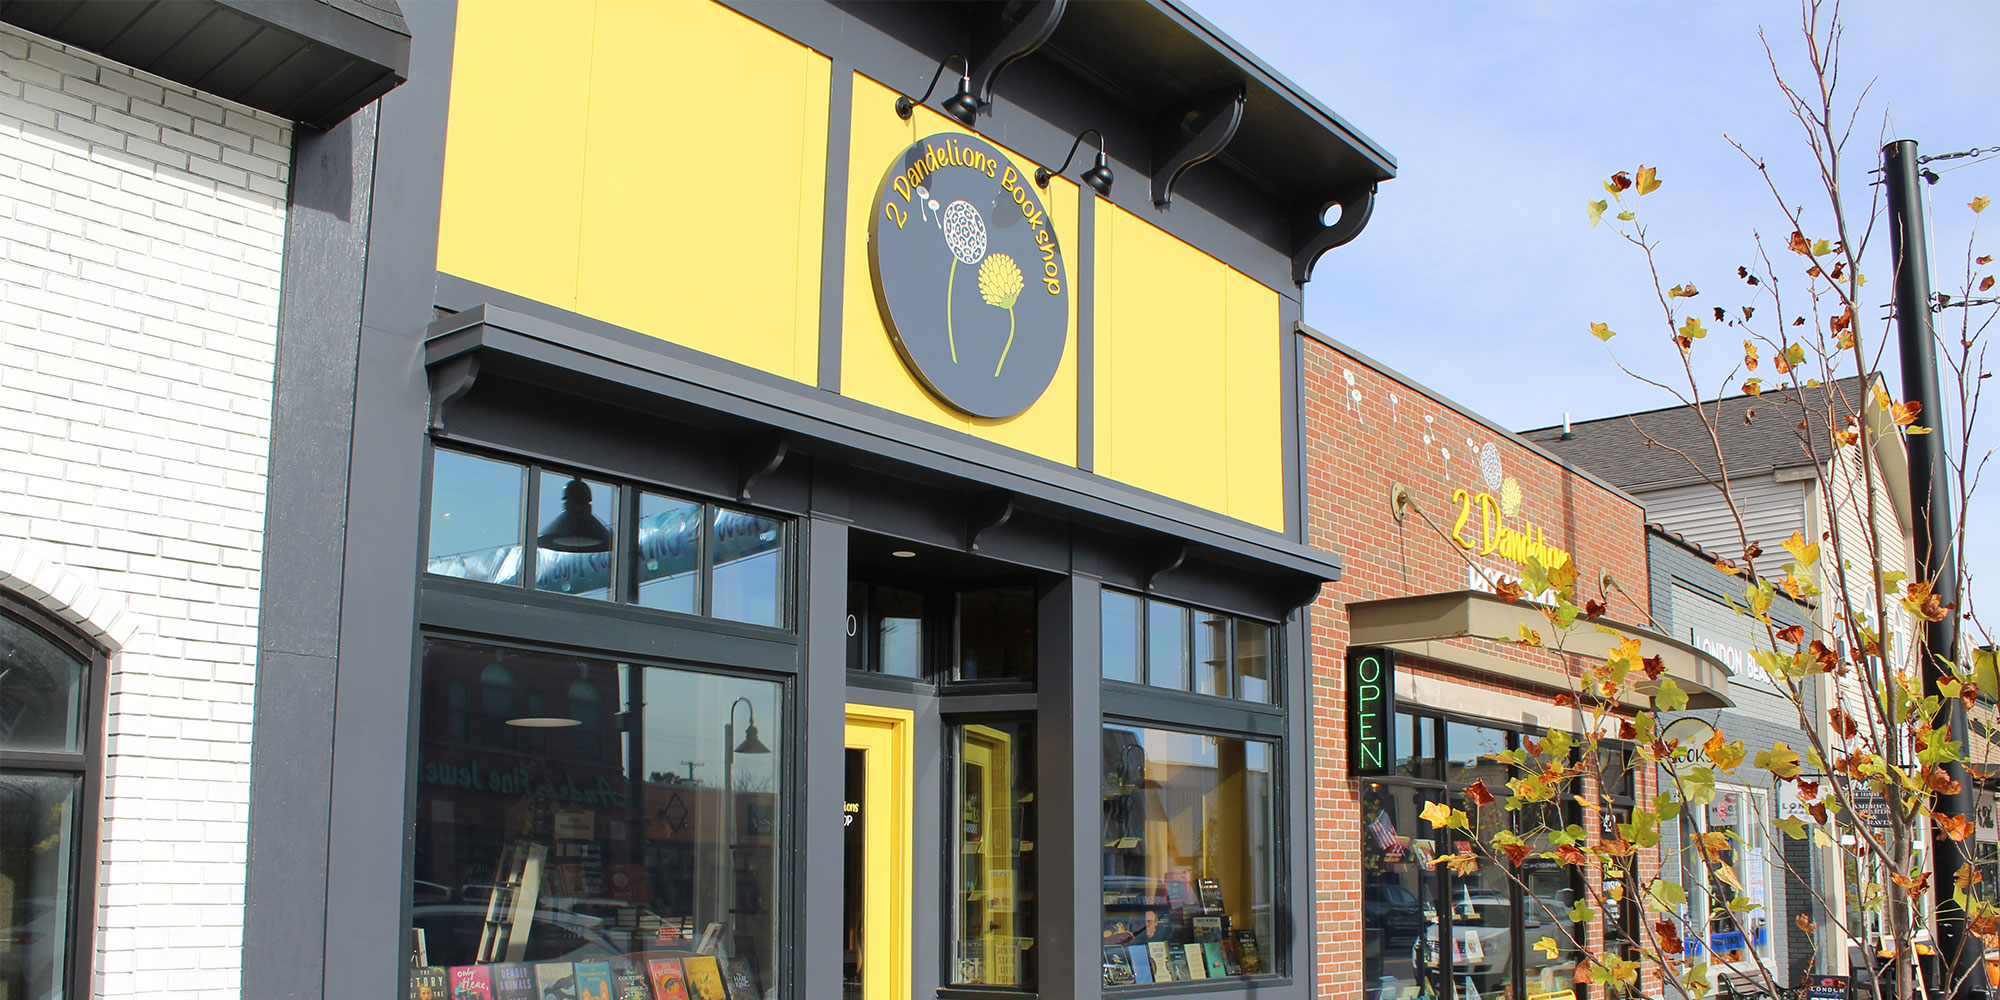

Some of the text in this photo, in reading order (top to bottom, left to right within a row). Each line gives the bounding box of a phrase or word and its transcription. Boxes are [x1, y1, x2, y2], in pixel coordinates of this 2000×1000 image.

[885, 139, 1062, 296] 2 Dandelions Bookshop
[1452, 488, 1476, 549] 2
[1358, 656, 1383, 770] OPEN
[499, 978, 532, 991] ANIMALS
[500, 967, 528, 979] DEADLY
